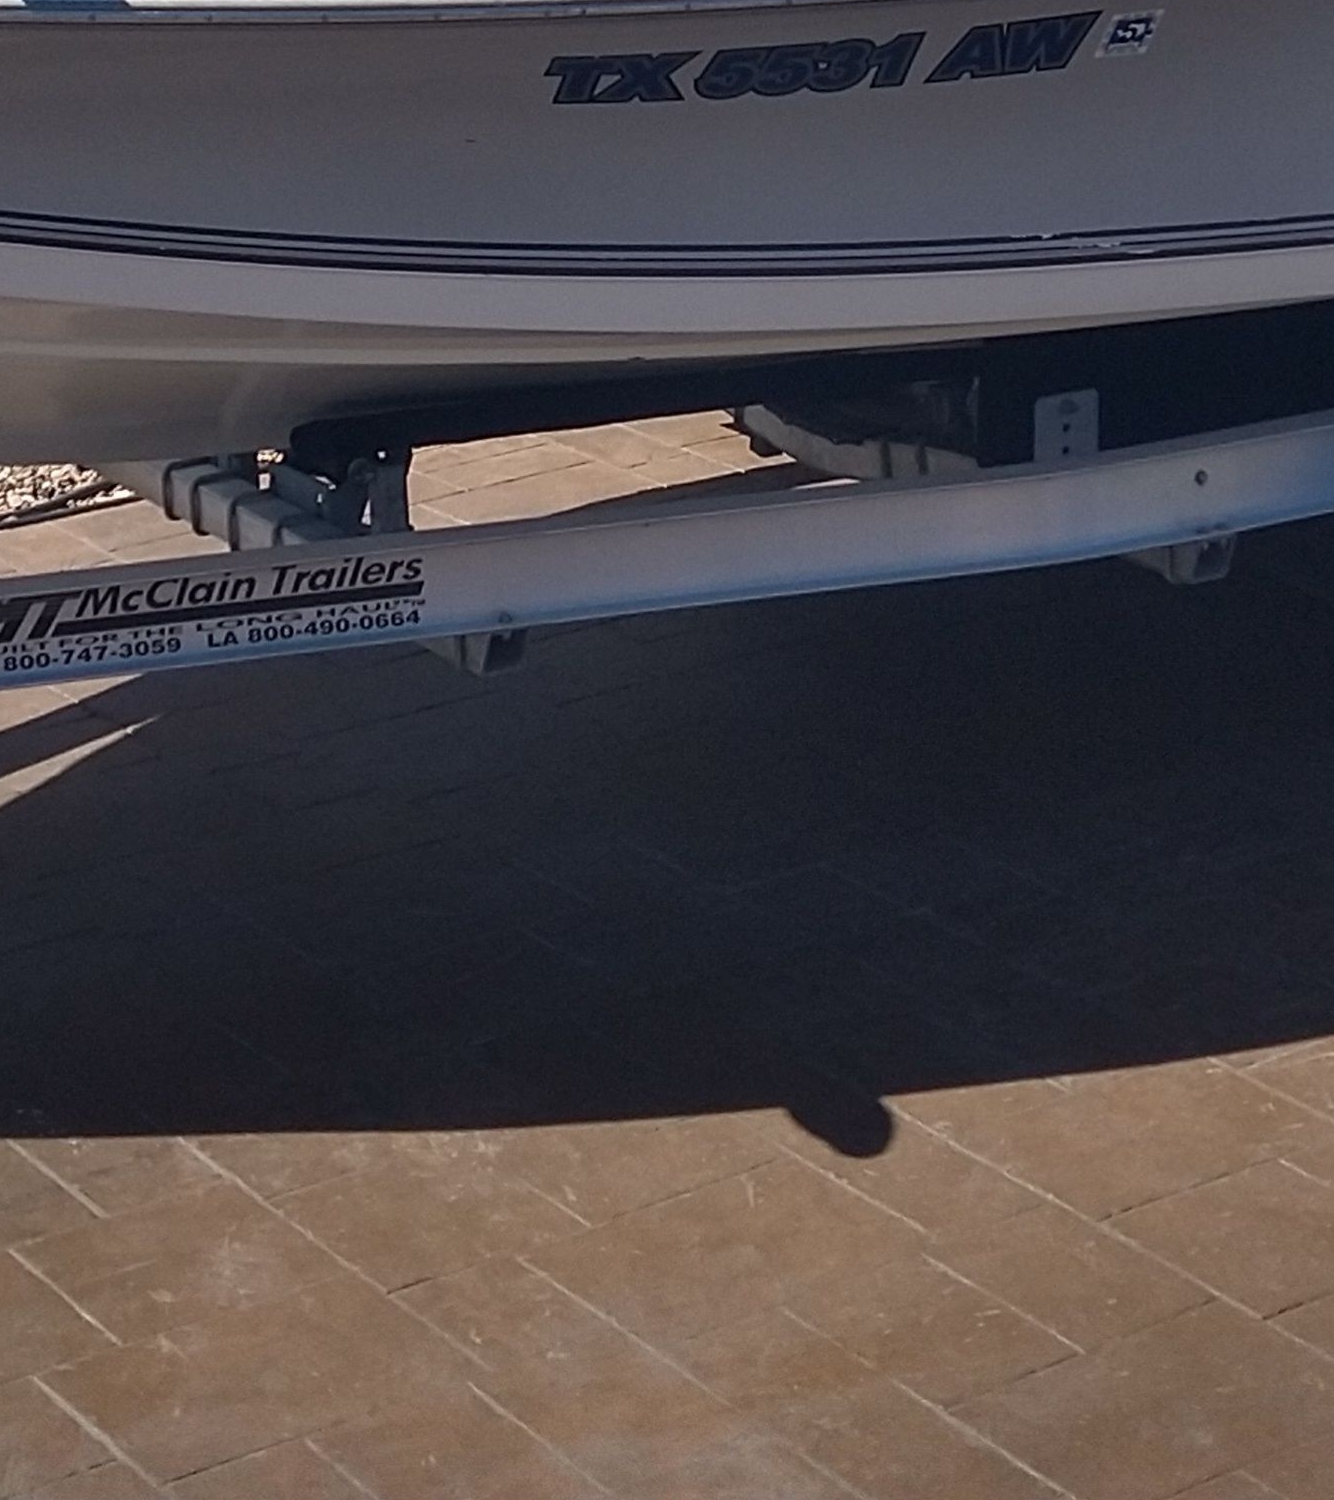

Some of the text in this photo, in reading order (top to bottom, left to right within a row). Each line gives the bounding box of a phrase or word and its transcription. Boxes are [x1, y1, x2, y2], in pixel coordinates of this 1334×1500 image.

[543, 10, 1105, 104] TX 5531 AW
[76, 556, 423, 618] McClain Trailers
[128, 626, 183, 640] THE
[196, 612, 304, 633] LONG
[207, 609, 421, 648] LA 800-490-0664
[3, 636, 182, 672] 800-747-3059
